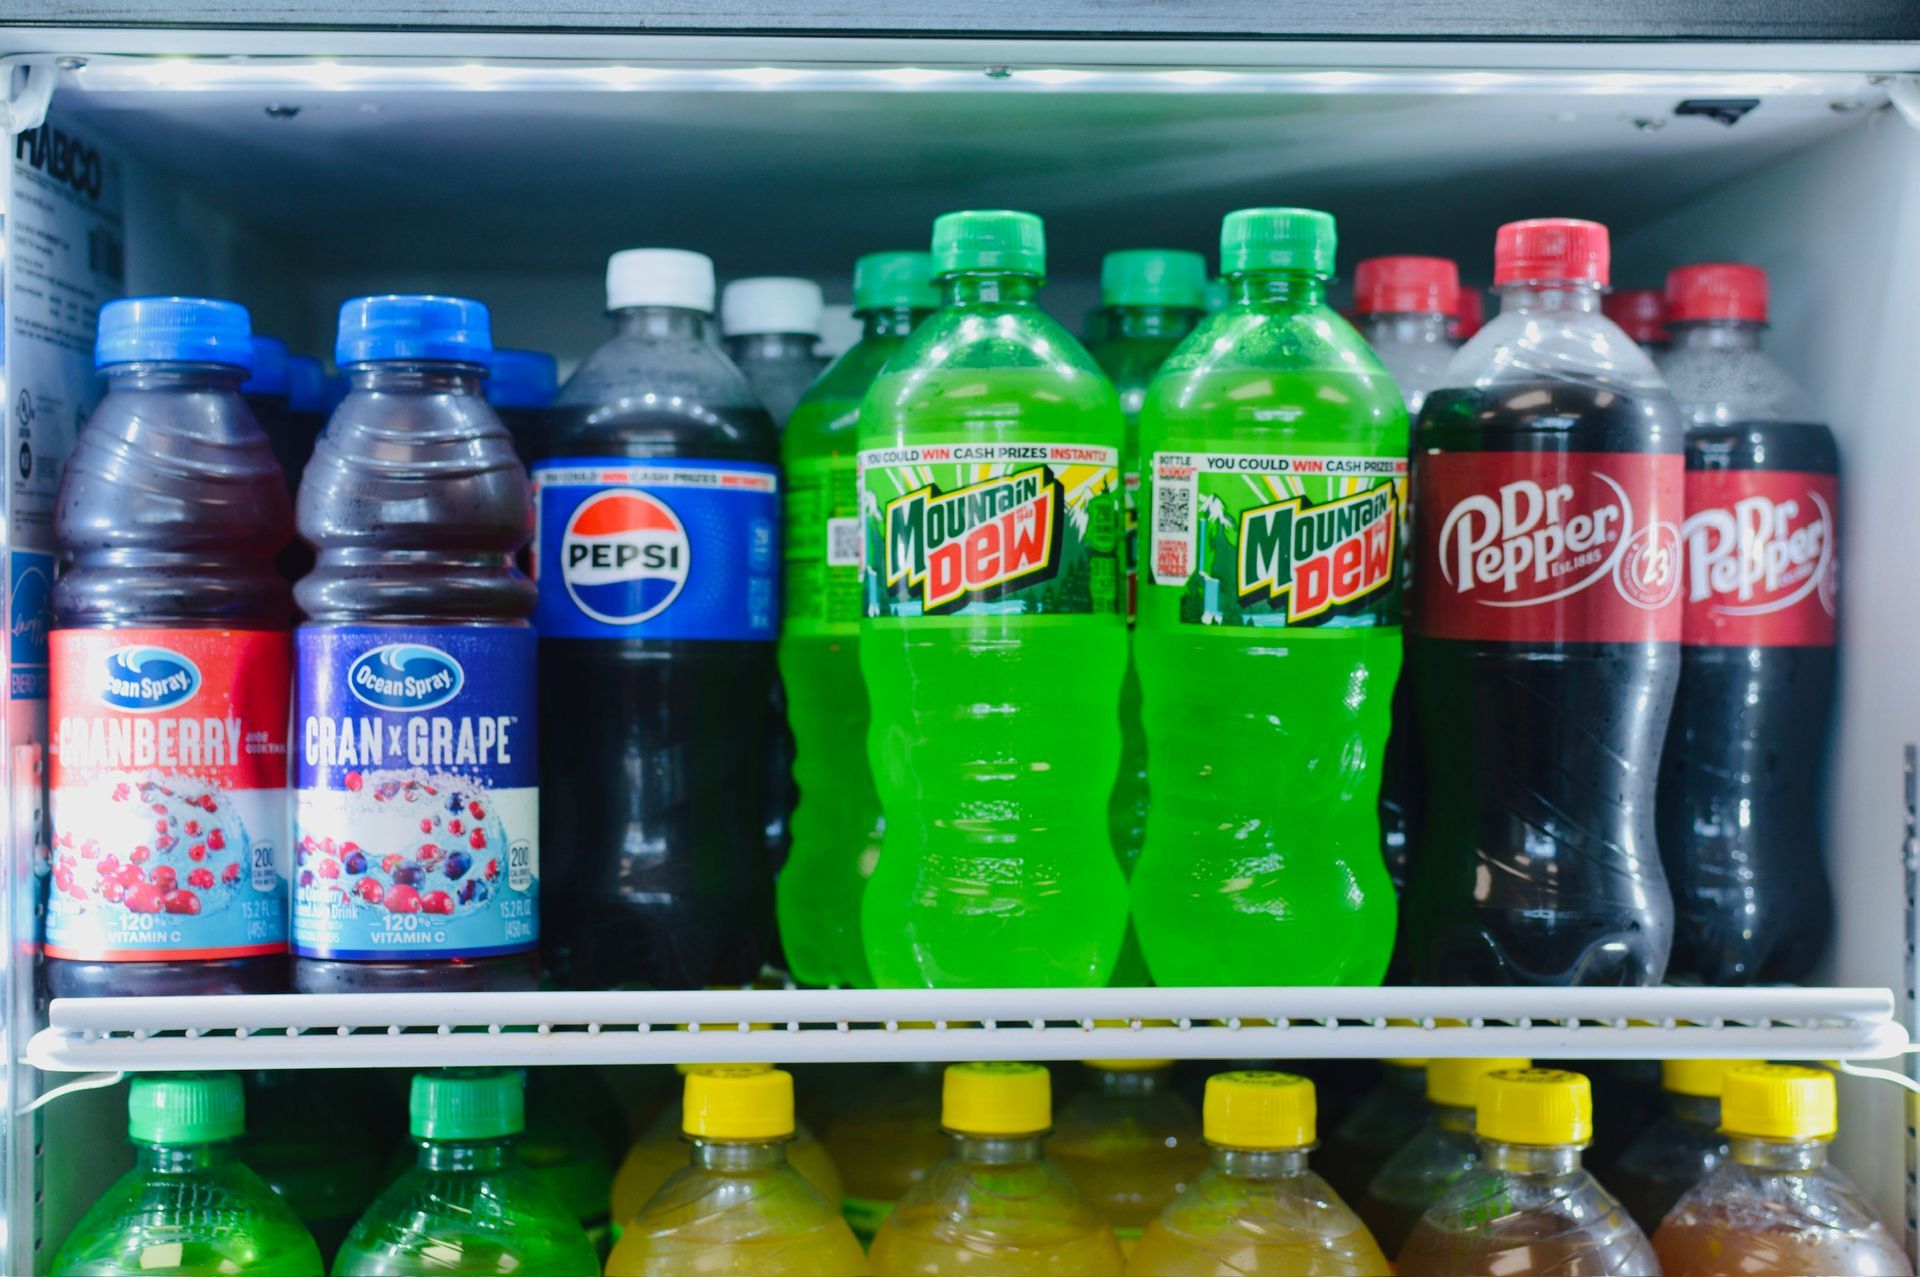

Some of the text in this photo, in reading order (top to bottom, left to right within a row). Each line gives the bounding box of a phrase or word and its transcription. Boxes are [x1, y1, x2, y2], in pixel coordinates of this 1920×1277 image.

[16, 122, 103, 199] HABCO
[883, 450, 919, 463] COULD
[922, 448, 950, 460] WIN
[953, 447, 994, 460] CASH
[998, 447, 1047, 459] PRIZES
[1207, 457, 1235, 470] YOU
[1239, 458, 1289, 471] COULD
[1293, 460, 1323, 472] WIN
[1326, 460, 1361, 472] CASH
[1364, 461, 1393, 472] PRIZES
[1501, 480, 1574, 539] Dr
[1735, 496, 1799, 556] Dr
[569, 544, 679, 569] PEPSI
[1440, 495, 1619, 593] Pepper
[1682, 508, 1824, 602] Pepper
[1641, 546, 1670, 587] 23
[104, 670, 188, 701] cean Spray
[356, 664, 451, 699] Ocean Spray
[59, 716, 242, 767] CRANBERRY
[332, 904, 358, 920] Drink
[383, 914, 431, 931] 120%
[108, 931, 181, 944] VITAMIN C
[370, 931, 446, 944] VITAMIN C
